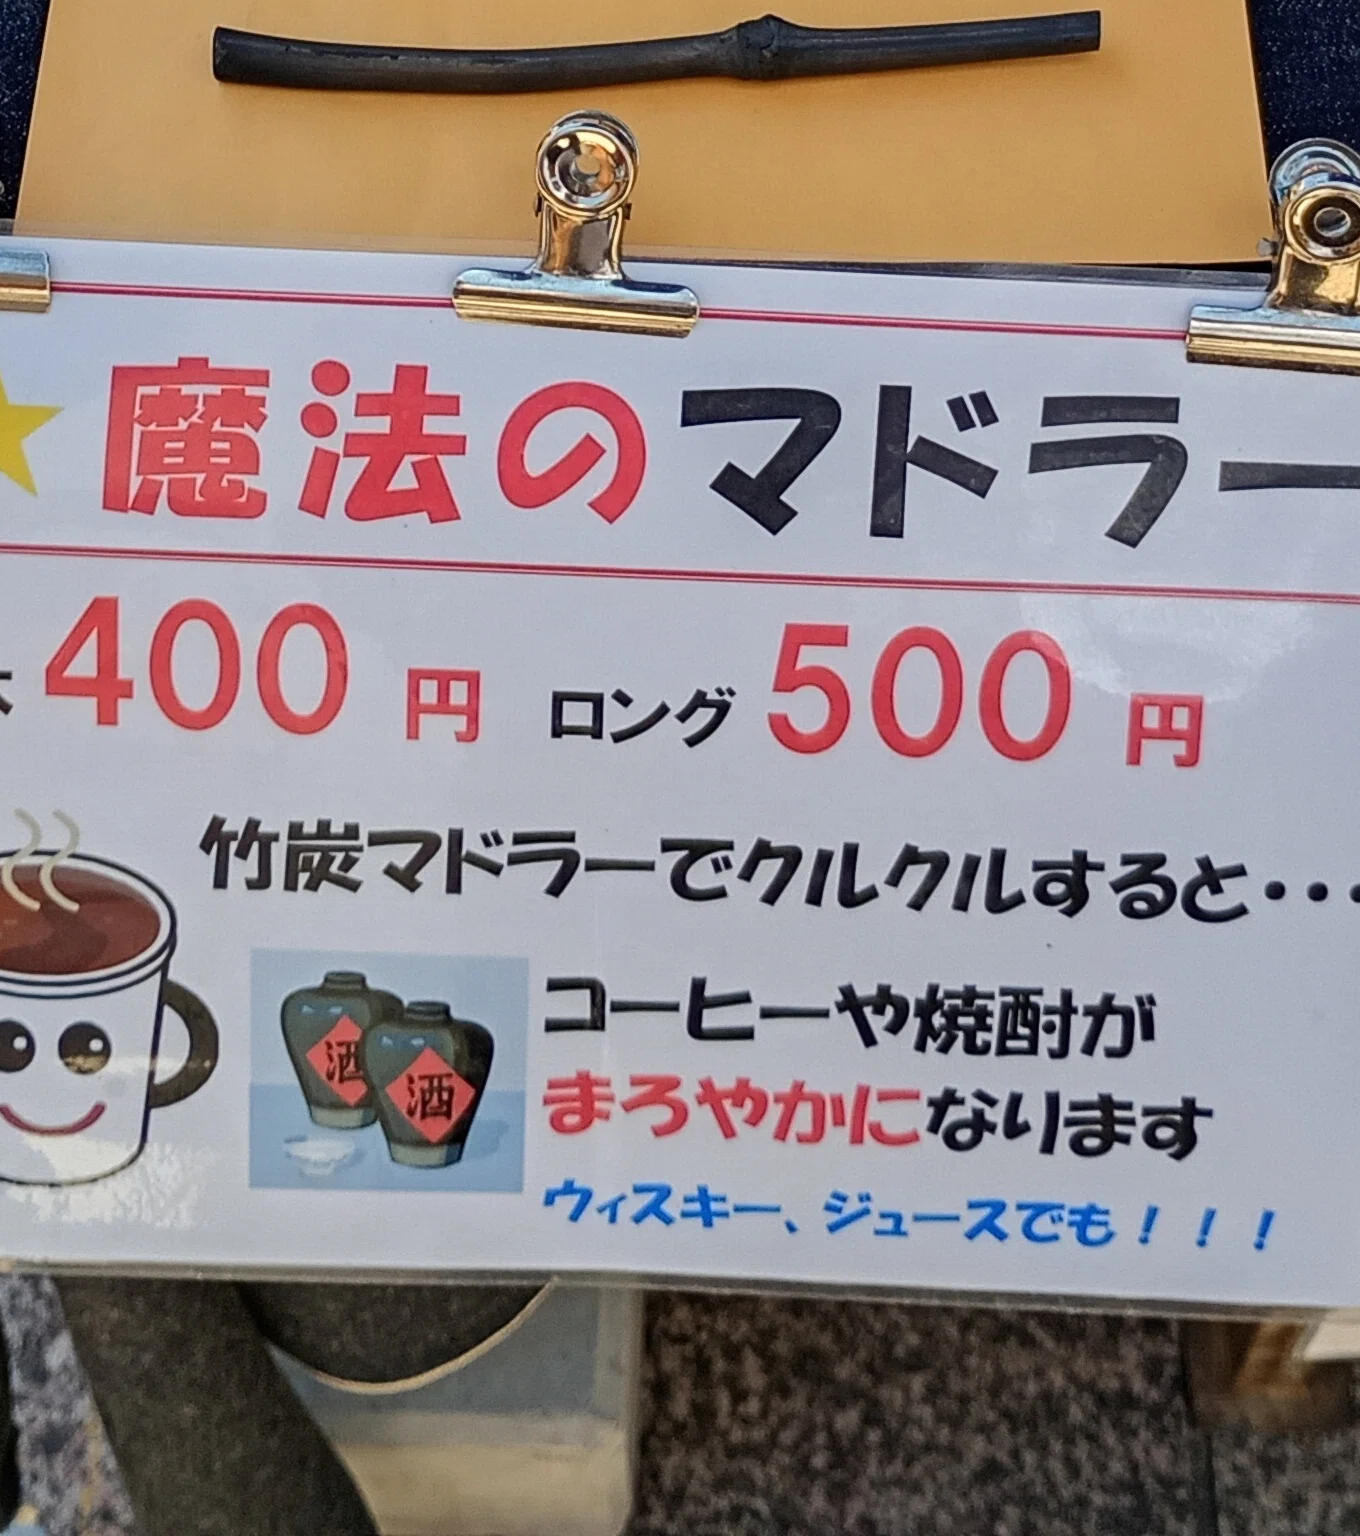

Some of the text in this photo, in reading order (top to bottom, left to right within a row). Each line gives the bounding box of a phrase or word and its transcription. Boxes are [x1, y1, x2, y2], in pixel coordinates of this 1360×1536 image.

[44, 595, 349, 736] 400
[405, 667, 482, 744] 円
[549, 684, 734, 750] ロング
[765, 622, 1073, 763] 500
[1124, 691, 1206, 770] 円
[543, 974, 1158, 1061] コーヒーや焼酎が
[405, 1072, 455, 1121] 酒
